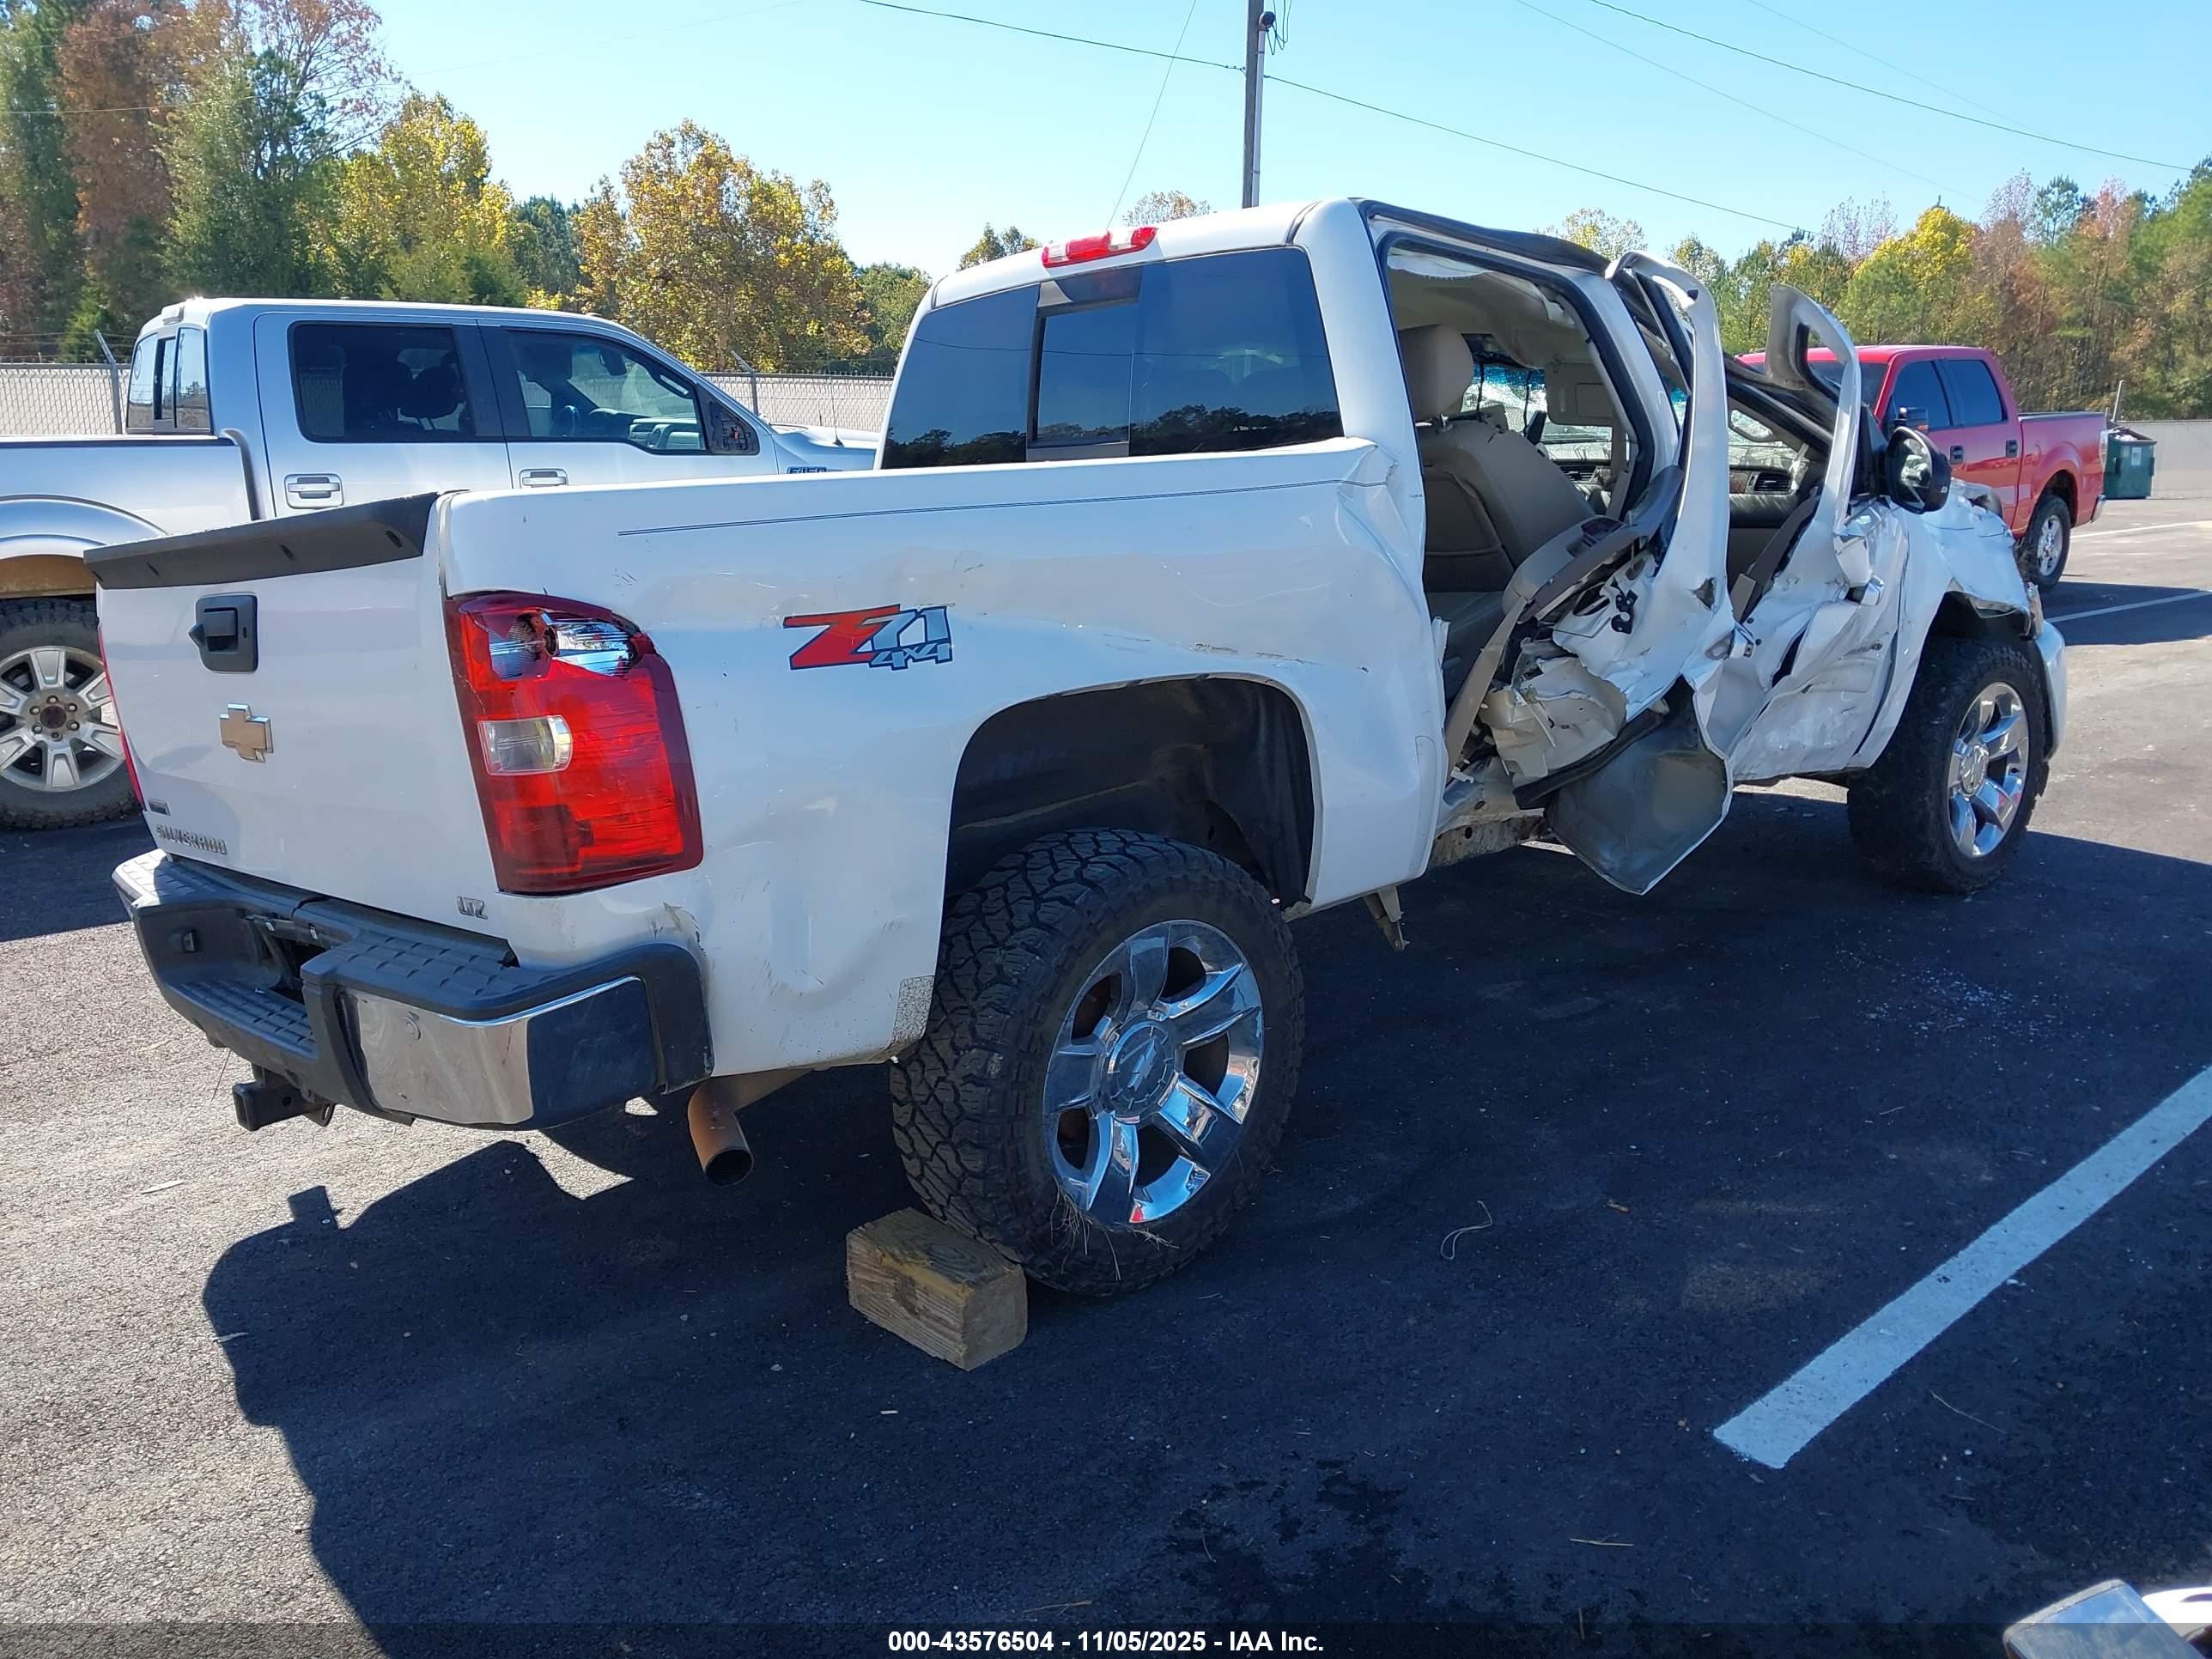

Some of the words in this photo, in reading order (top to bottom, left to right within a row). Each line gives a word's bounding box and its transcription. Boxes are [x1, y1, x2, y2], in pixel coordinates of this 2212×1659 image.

[782, 603, 951, 671] Z71
[156, 824, 228, 855] SILVERADO
[456, 895, 489, 921] LTZ
